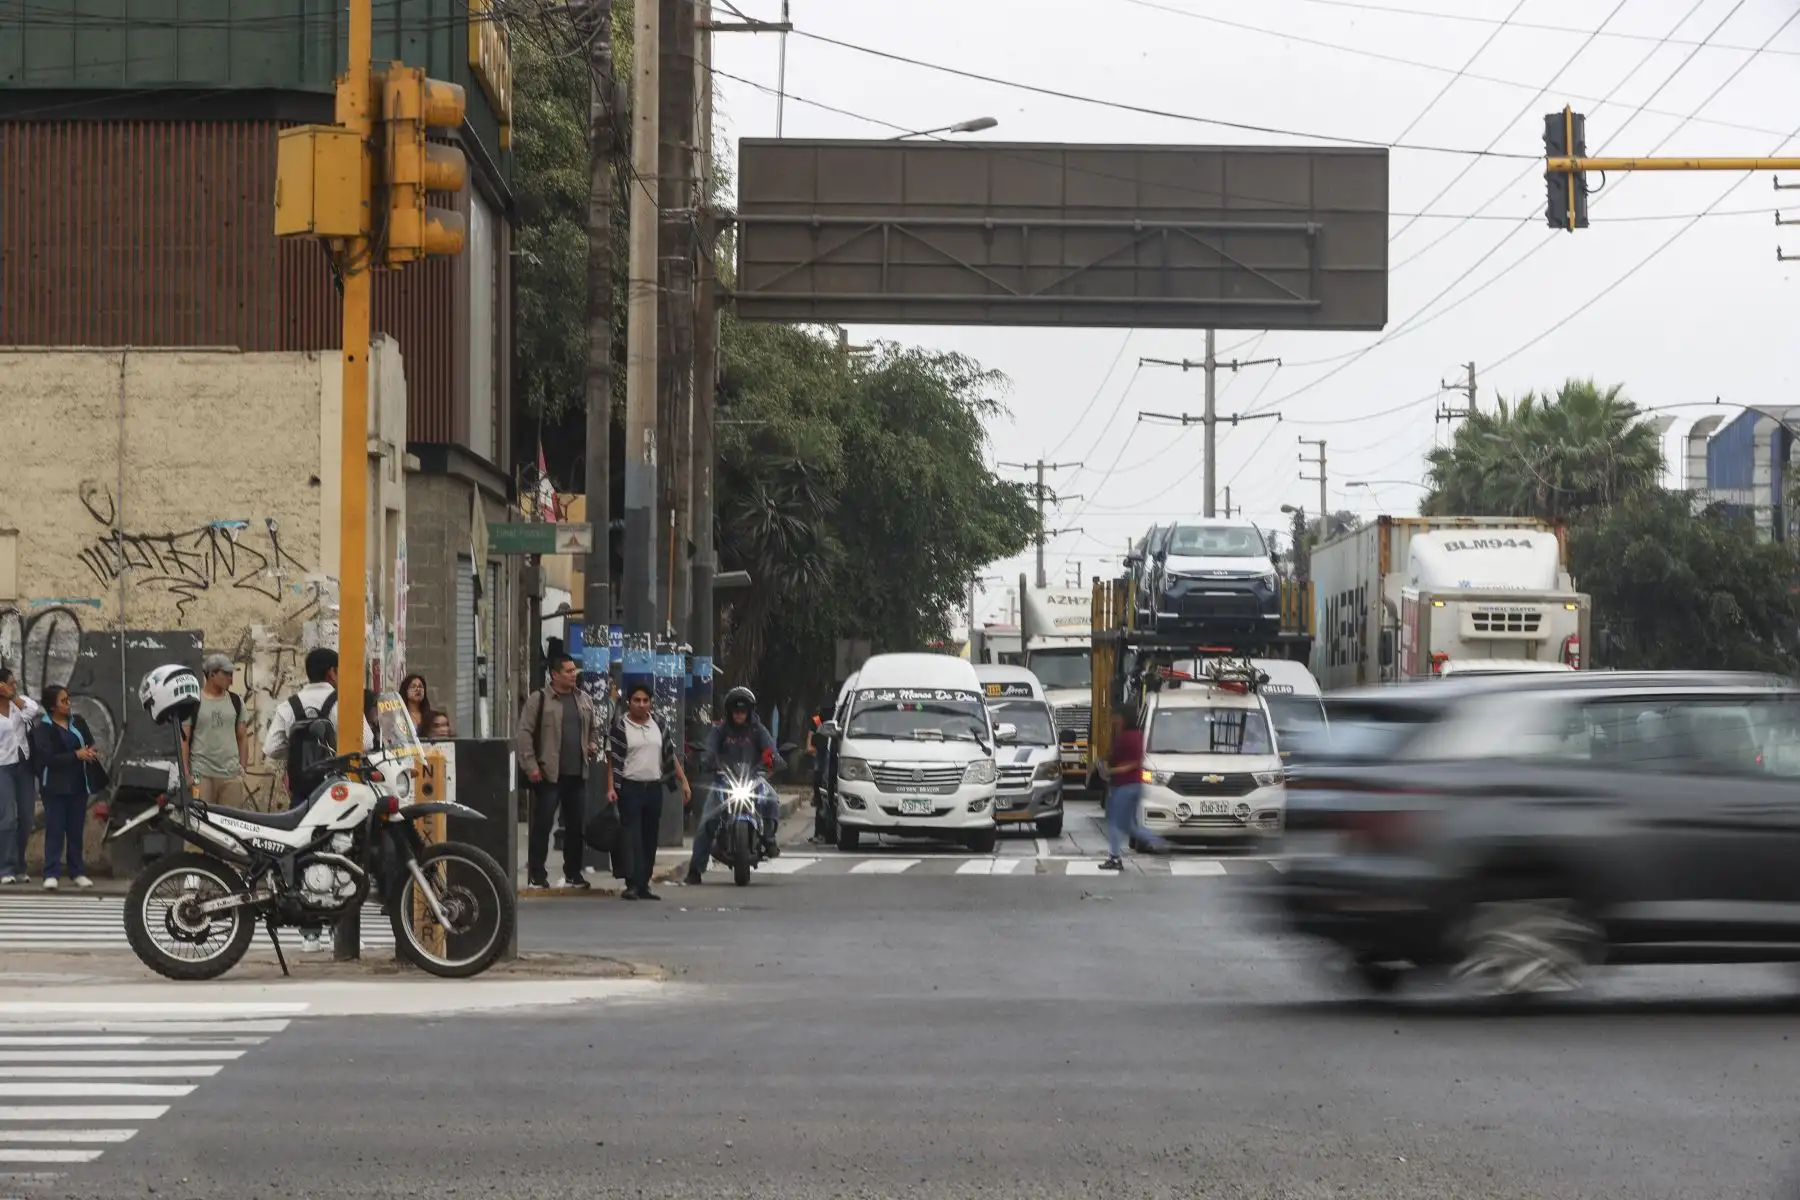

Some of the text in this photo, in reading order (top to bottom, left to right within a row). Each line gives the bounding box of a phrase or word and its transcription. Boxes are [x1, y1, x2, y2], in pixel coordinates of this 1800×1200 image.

[1444, 539, 1532, 552] BLM944
[1047, 595, 1090, 605] AZH7
[252, 837, 285, 853] PL-19777
